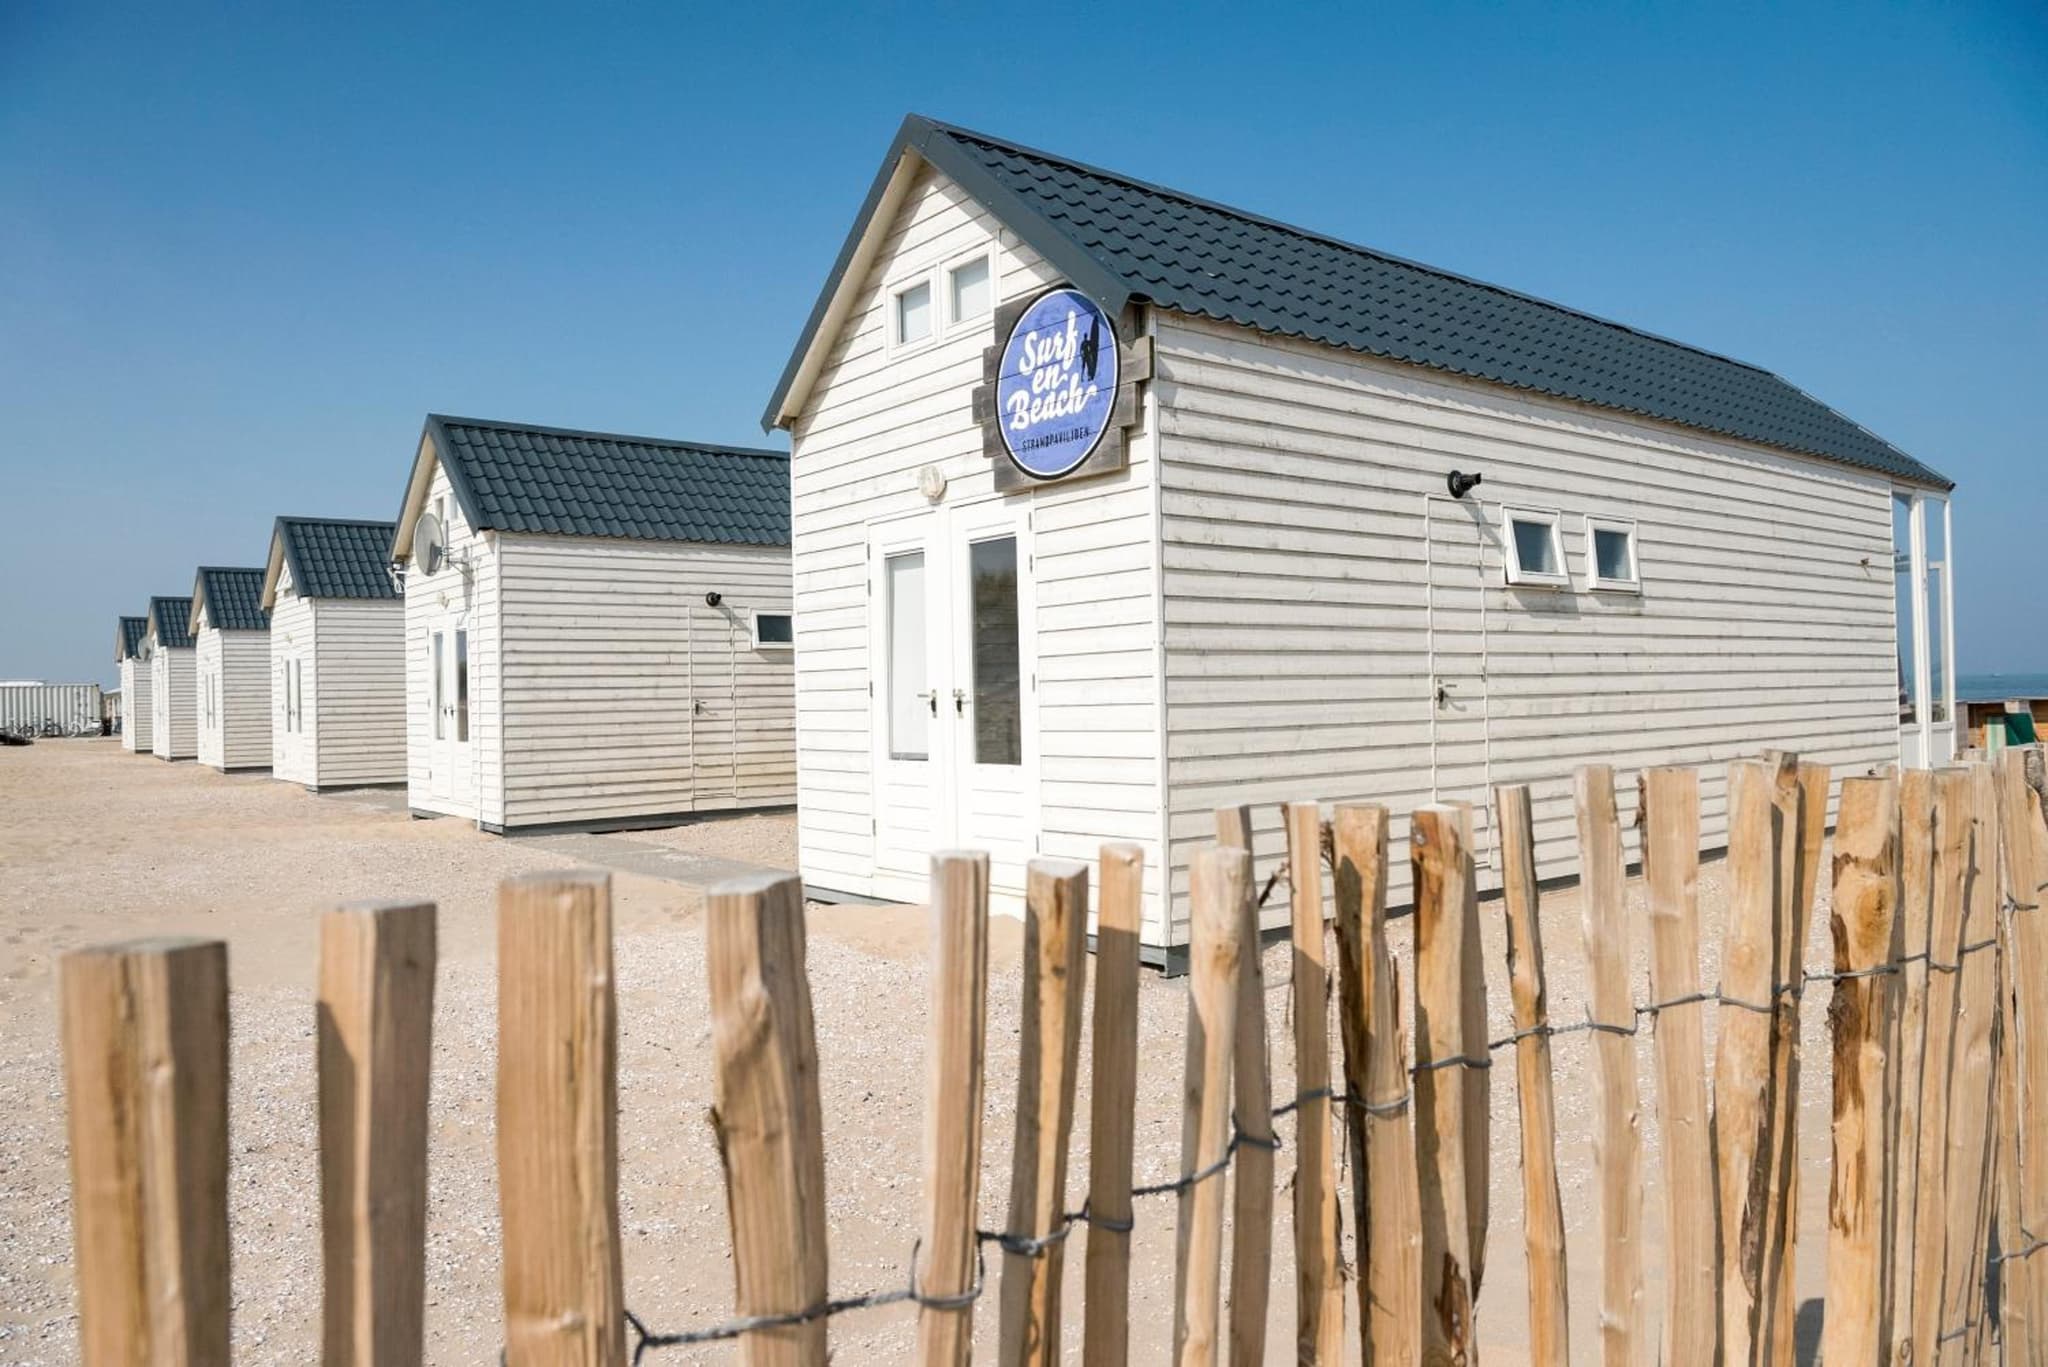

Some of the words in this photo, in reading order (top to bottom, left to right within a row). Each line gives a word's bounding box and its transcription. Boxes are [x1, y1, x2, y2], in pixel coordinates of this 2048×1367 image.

[1019, 311, 1078, 375] Surf
[1007, 373, 1097, 430] Beach
[1032, 364, 1068, 394] en
